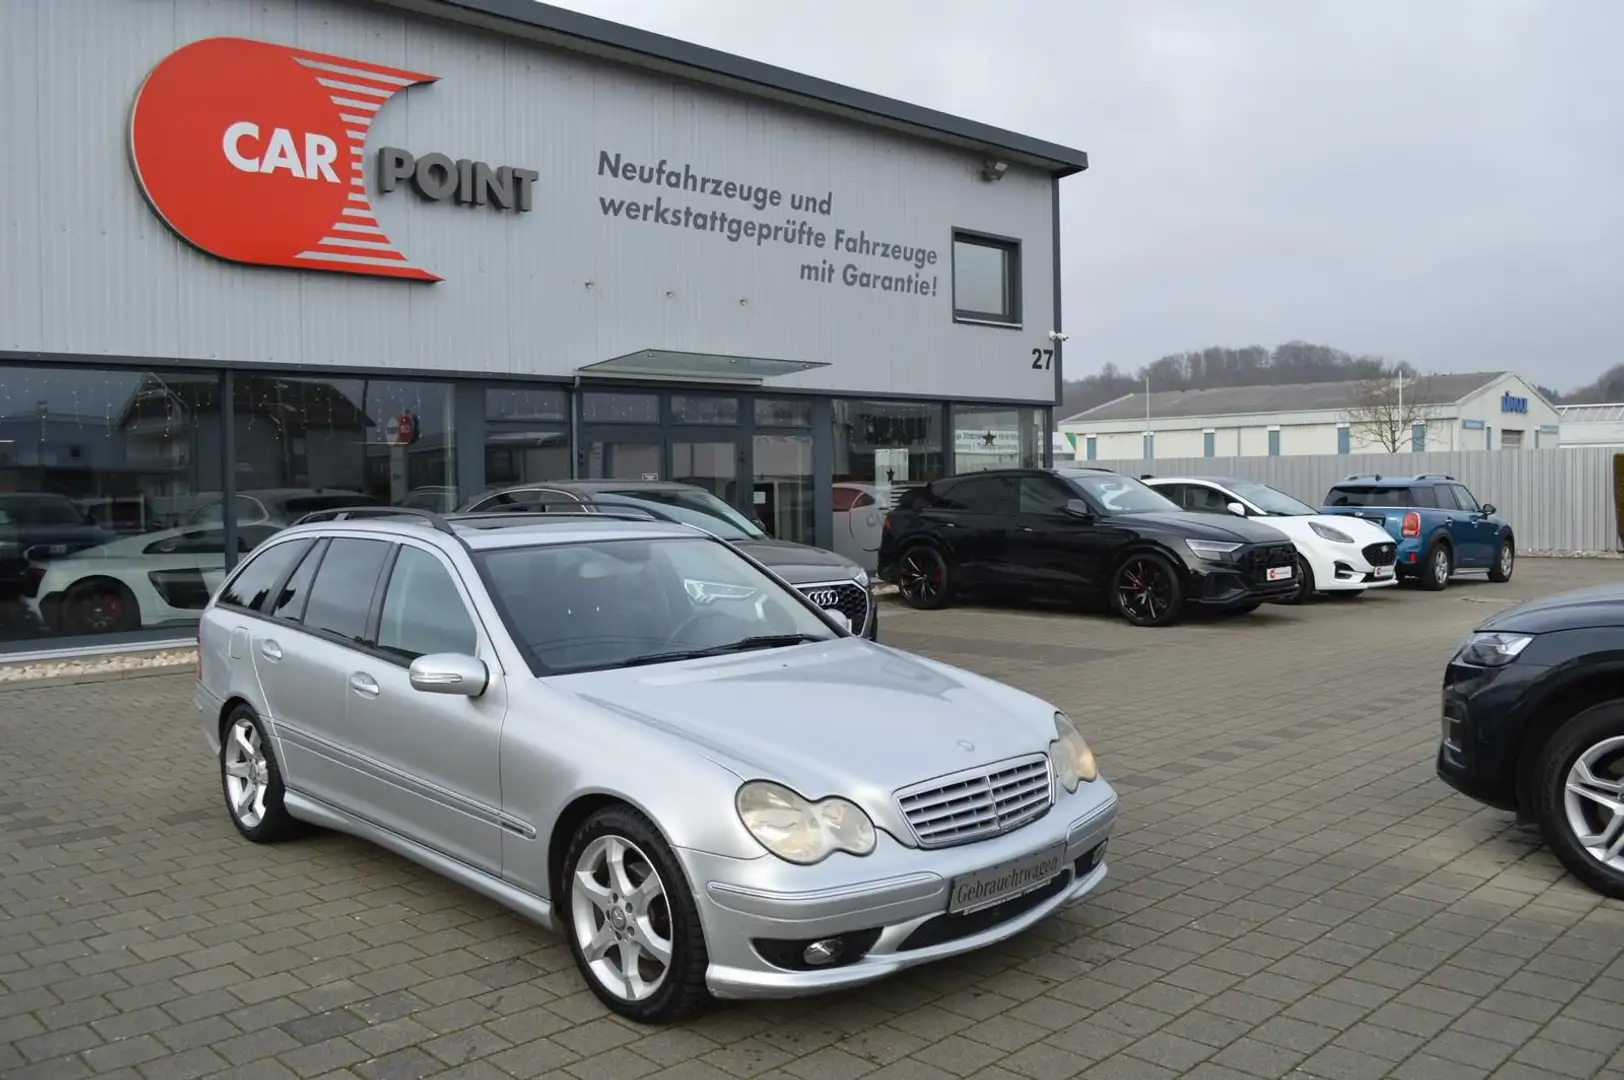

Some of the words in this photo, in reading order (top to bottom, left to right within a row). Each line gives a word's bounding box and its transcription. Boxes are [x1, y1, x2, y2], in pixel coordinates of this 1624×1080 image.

[222, 121, 341, 184] CAR
[377, 146, 539, 212] POINT
[597, 149, 782, 211] Neufahrzeuge
[790, 190, 833, 215] und
[599, 192, 827, 248] werkstattgeprüfte
[834, 228, 938, 269] Fahrzeuge
[799, 261, 836, 285] mit
[842, 263, 938, 298] Garantie!
[1031, 348, 1054, 370] 27
[957, 856, 1059, 905] Gebrauchtwagen
